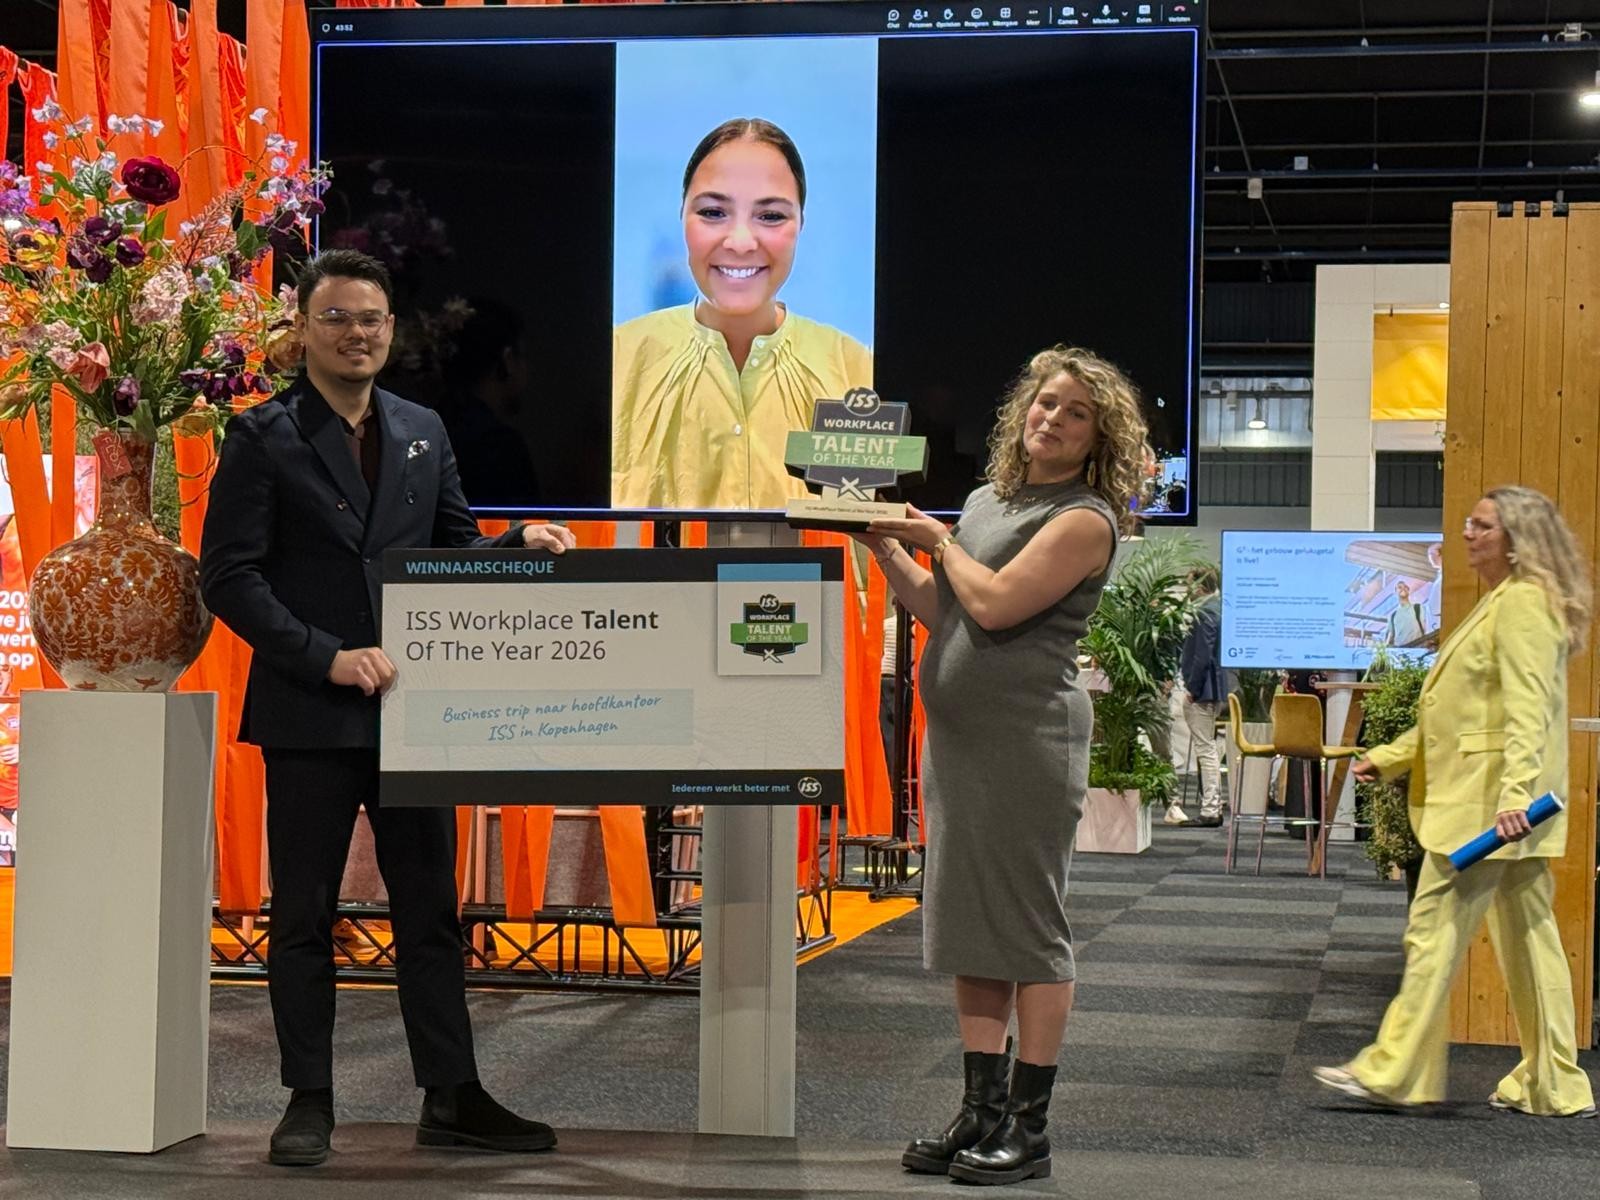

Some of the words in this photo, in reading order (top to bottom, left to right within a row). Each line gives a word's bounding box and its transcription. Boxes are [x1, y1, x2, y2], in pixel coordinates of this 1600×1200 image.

[847, 393, 877, 408] ISS
[823, 418, 895, 431] WORKPLACE
[812, 434, 899, 455] TALENT
[813, 453, 832, 463] OF
[834, 454, 858, 465] THE
[862, 455, 895, 467] YEAR
[406, 561, 555, 575] WINNAARSCHEQUE
[0, 590, 28, 609] 20
[406, 611, 441, 630] ISS
[449, 609, 574, 635] Workplace
[581, 609, 659, 629] Talent
[746, 624, 793, 635] TALENT
[406, 640, 436, 660] Of
[441, 641, 484, 660] The
[491, 640, 544, 660] Year
[551, 640, 606, 660] 2026
[8, 653, 34, 670] op
[442, 706, 501, 723] Business
[506, 706, 530, 720] trip
[536, 704, 567, 715] naar
[572, 694, 662, 712] hoofdkantoor
[488, 724, 516, 741] ISS
[520, 726, 533, 737] in
[538, 720, 618, 738] Kopenhagen
[672, 784, 713, 793] Iedereen
[715, 784, 742, 793] werkt
[744, 784, 770, 793] beter
[771, 784, 791, 793] met
